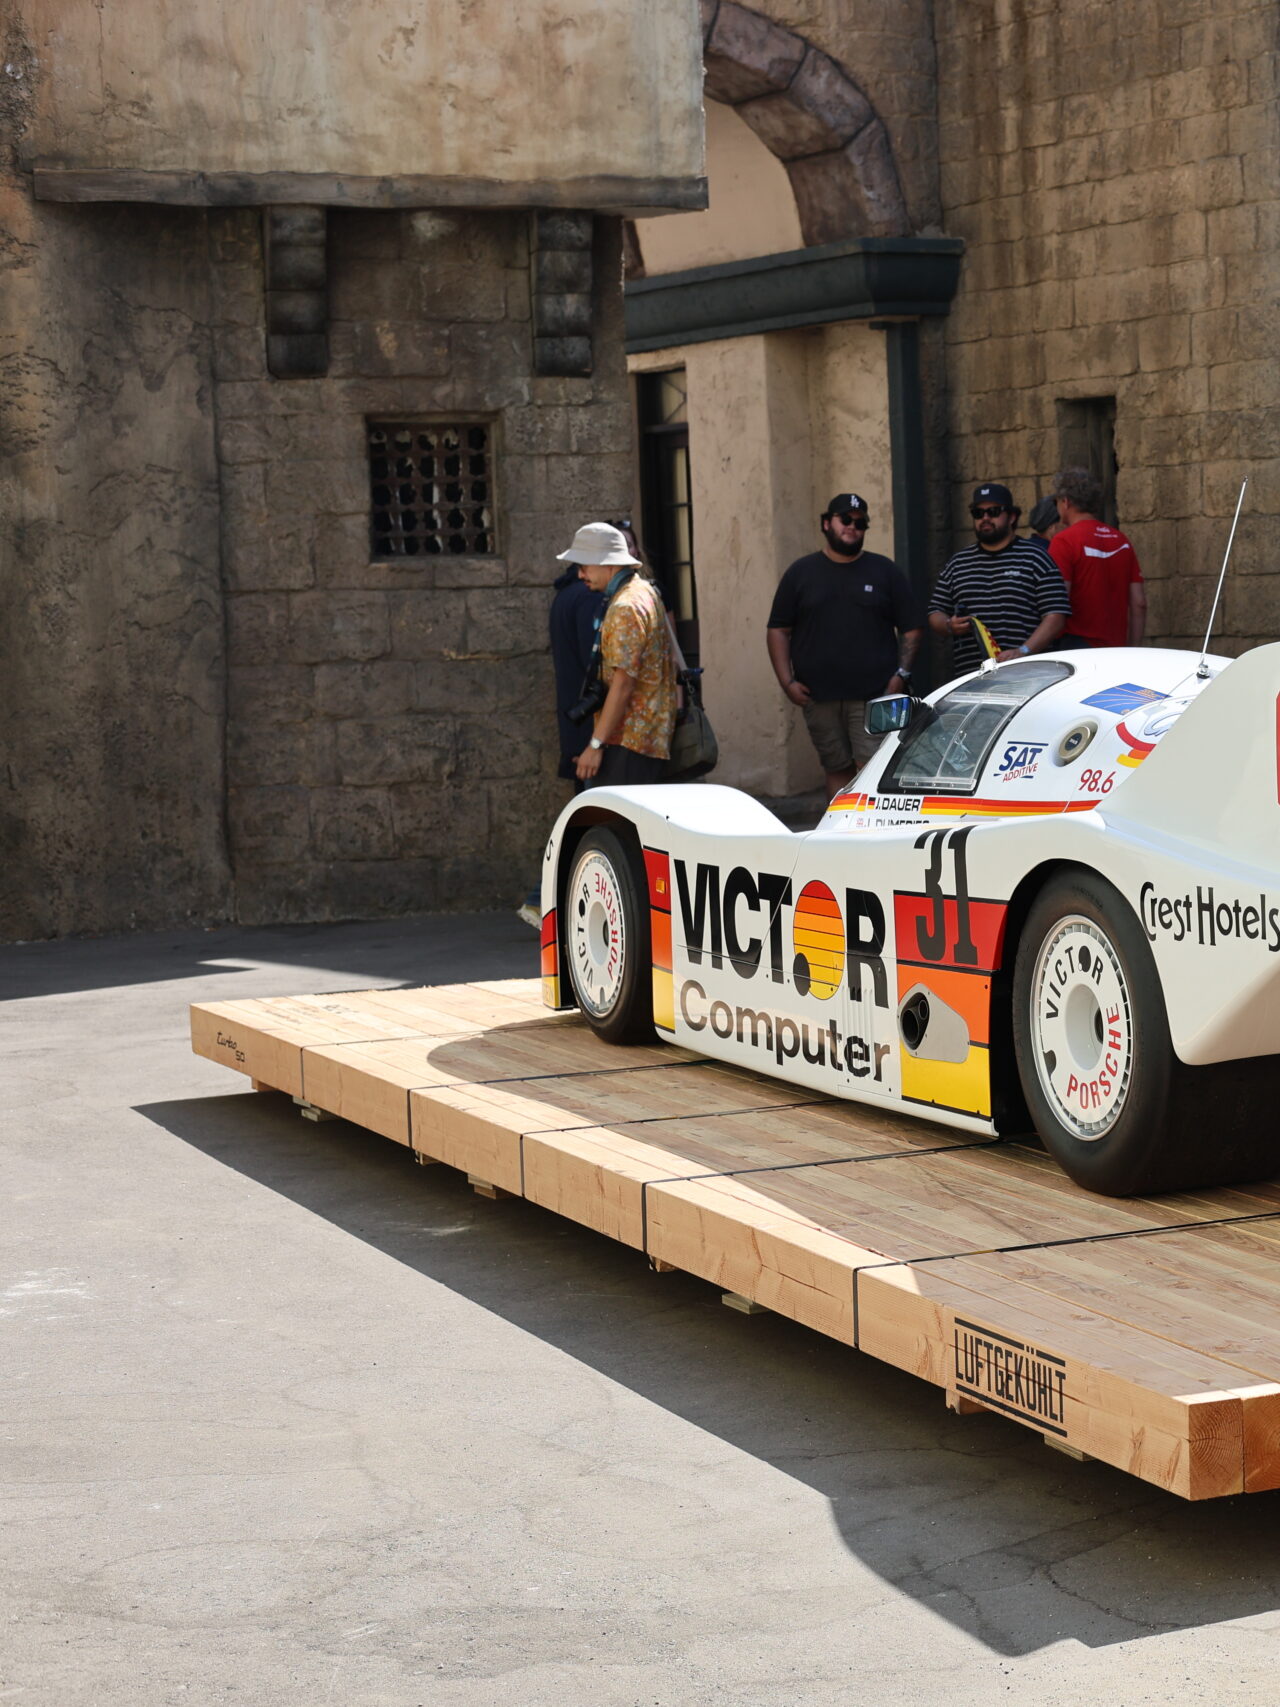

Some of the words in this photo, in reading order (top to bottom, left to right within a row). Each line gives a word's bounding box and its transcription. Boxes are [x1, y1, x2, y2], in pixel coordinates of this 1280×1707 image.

[998, 746, 1043, 771] SAT
[1003, 762, 1038, 783] ADDITIVE
[1078, 768, 1116, 794] 98.6
[594, 872, 618, 982] PORSCHE
[913, 823, 980, 966] 31
[1140, 881, 1192, 942] Crest
[680, 980, 890, 1083] Computer
[1066, 1002, 1122, 1110] PORSCHE
[954, 1328, 1066, 1424] LUFTGEKÜHLT
